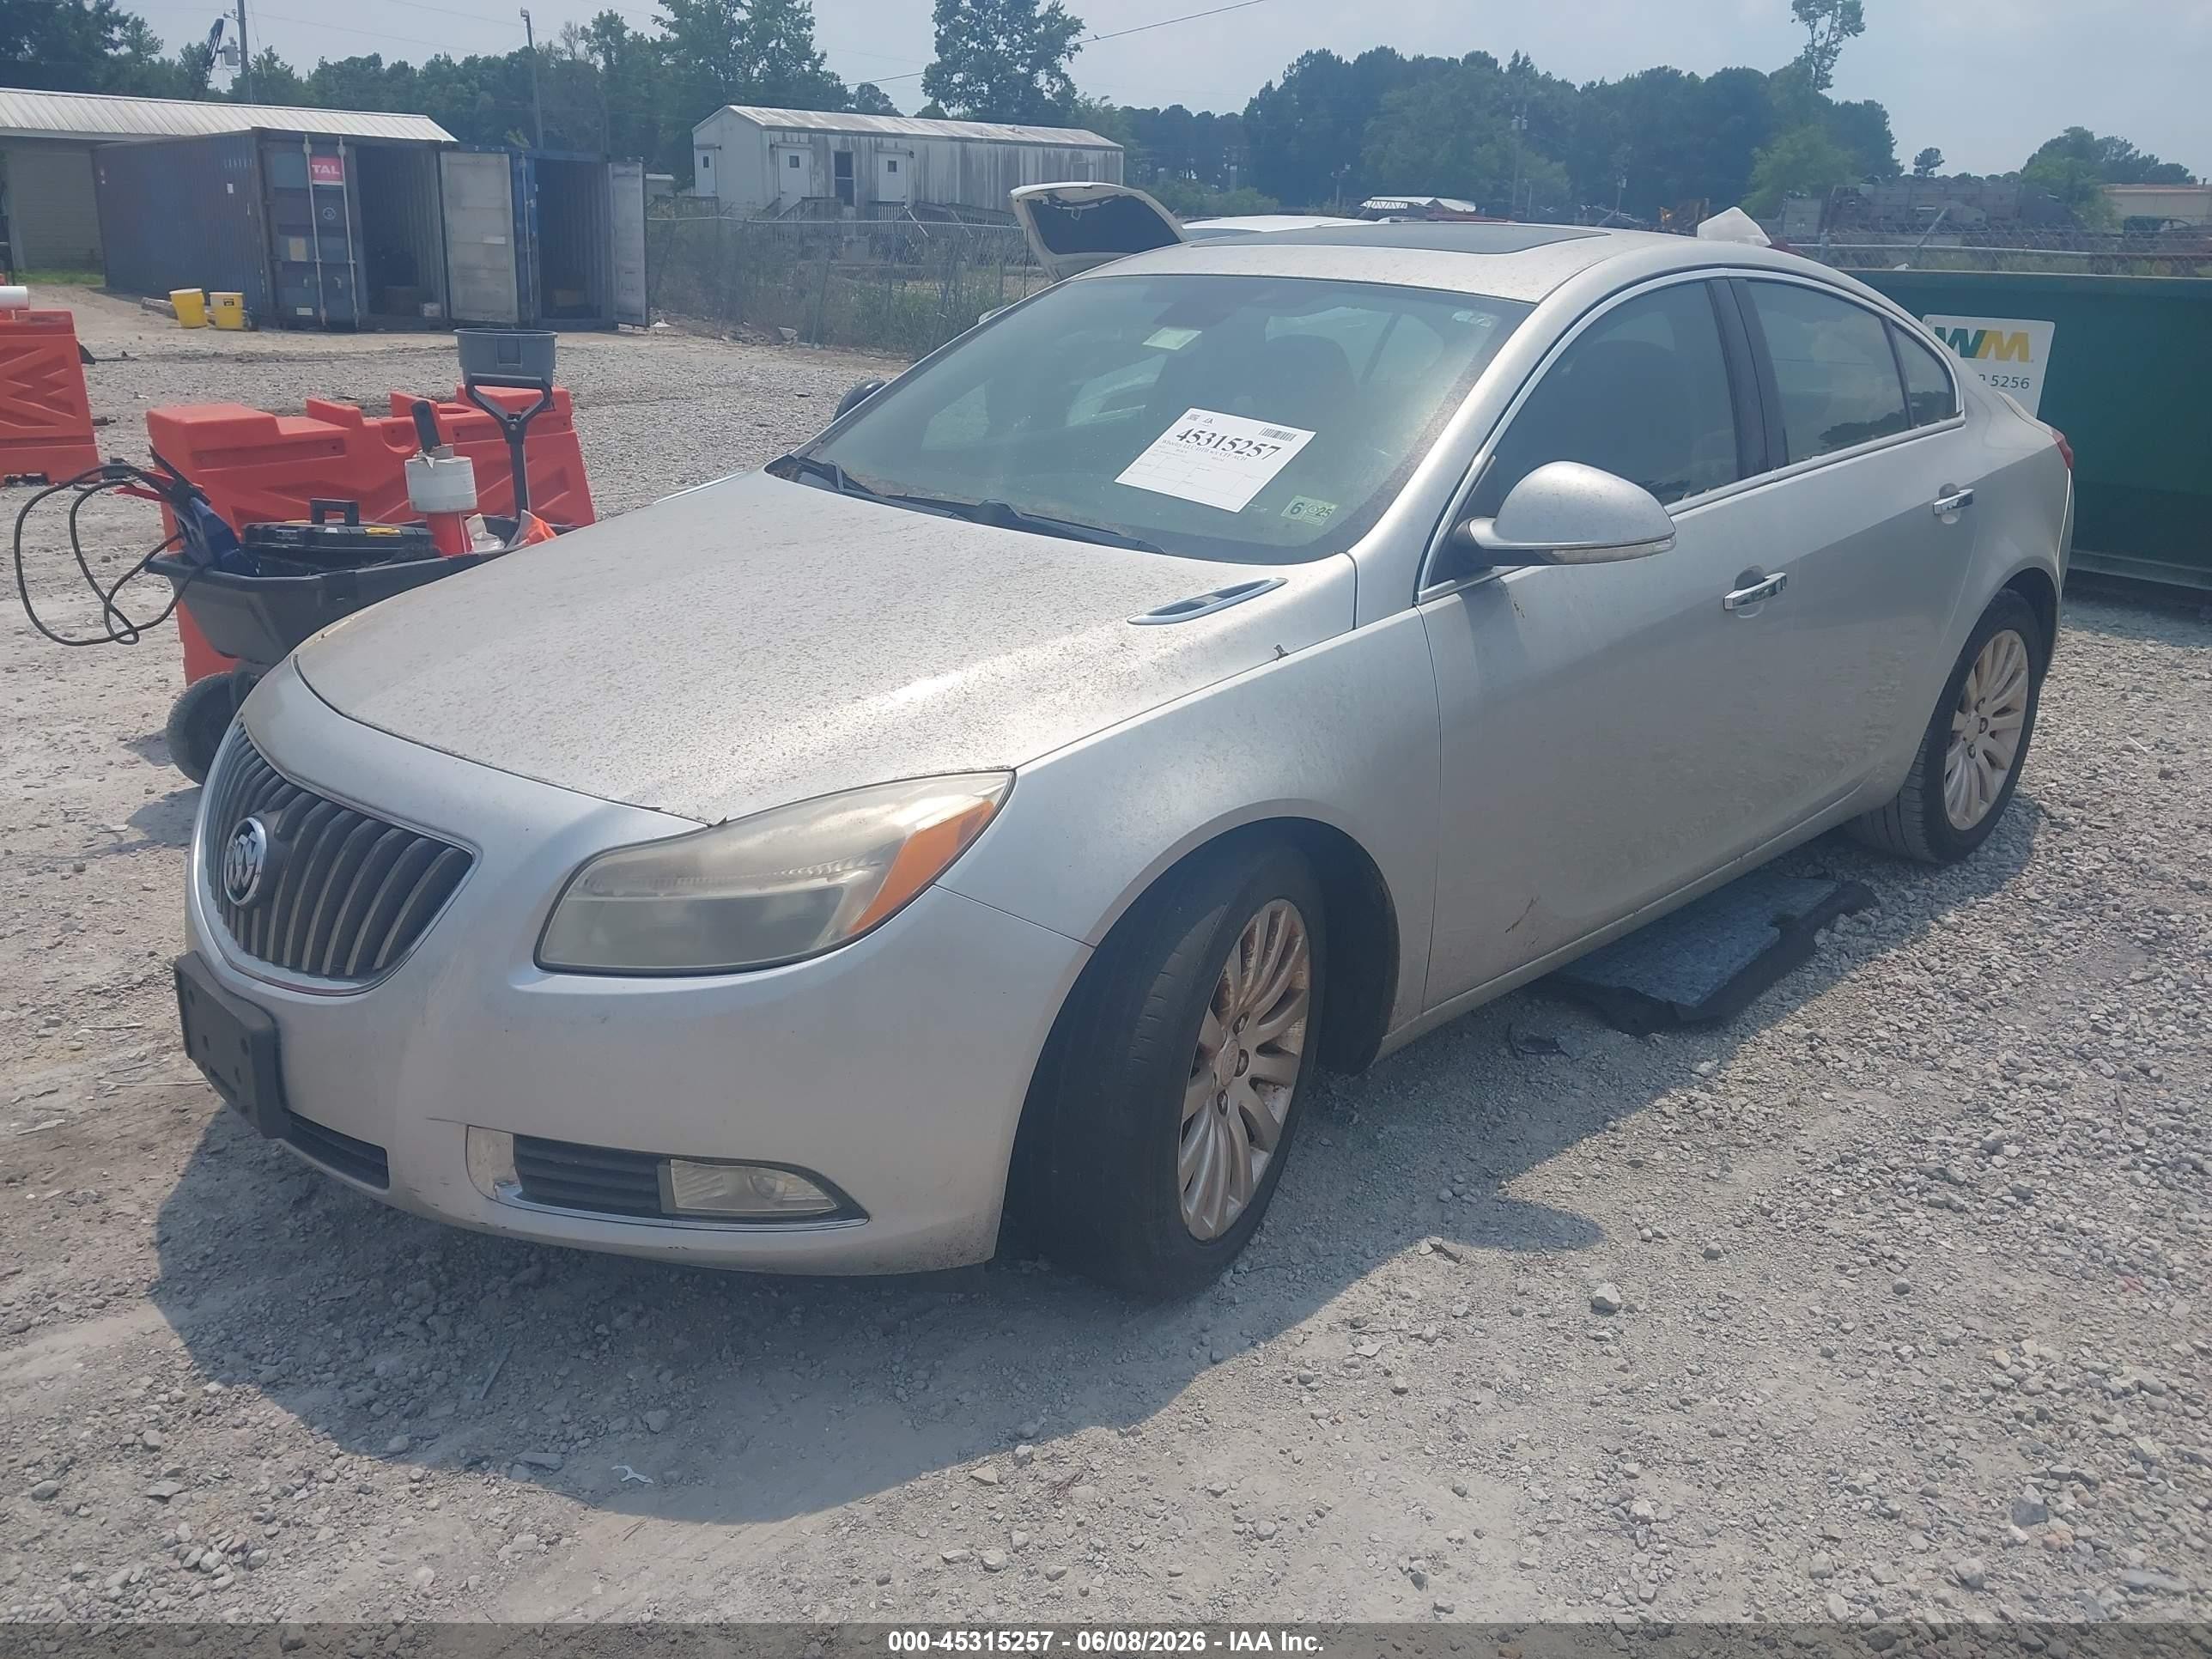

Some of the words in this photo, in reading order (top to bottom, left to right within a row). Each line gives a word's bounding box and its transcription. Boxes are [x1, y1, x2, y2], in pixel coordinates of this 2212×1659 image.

[311, 164, 341, 175] TAL
[1934, 326, 2030, 362] WM
[1990, 374, 2030, 390] 5256
[1176, 428, 1281, 459] 45315257
[1290, 502, 1304, 515] 6
[1316, 507, 1333, 517] 25
